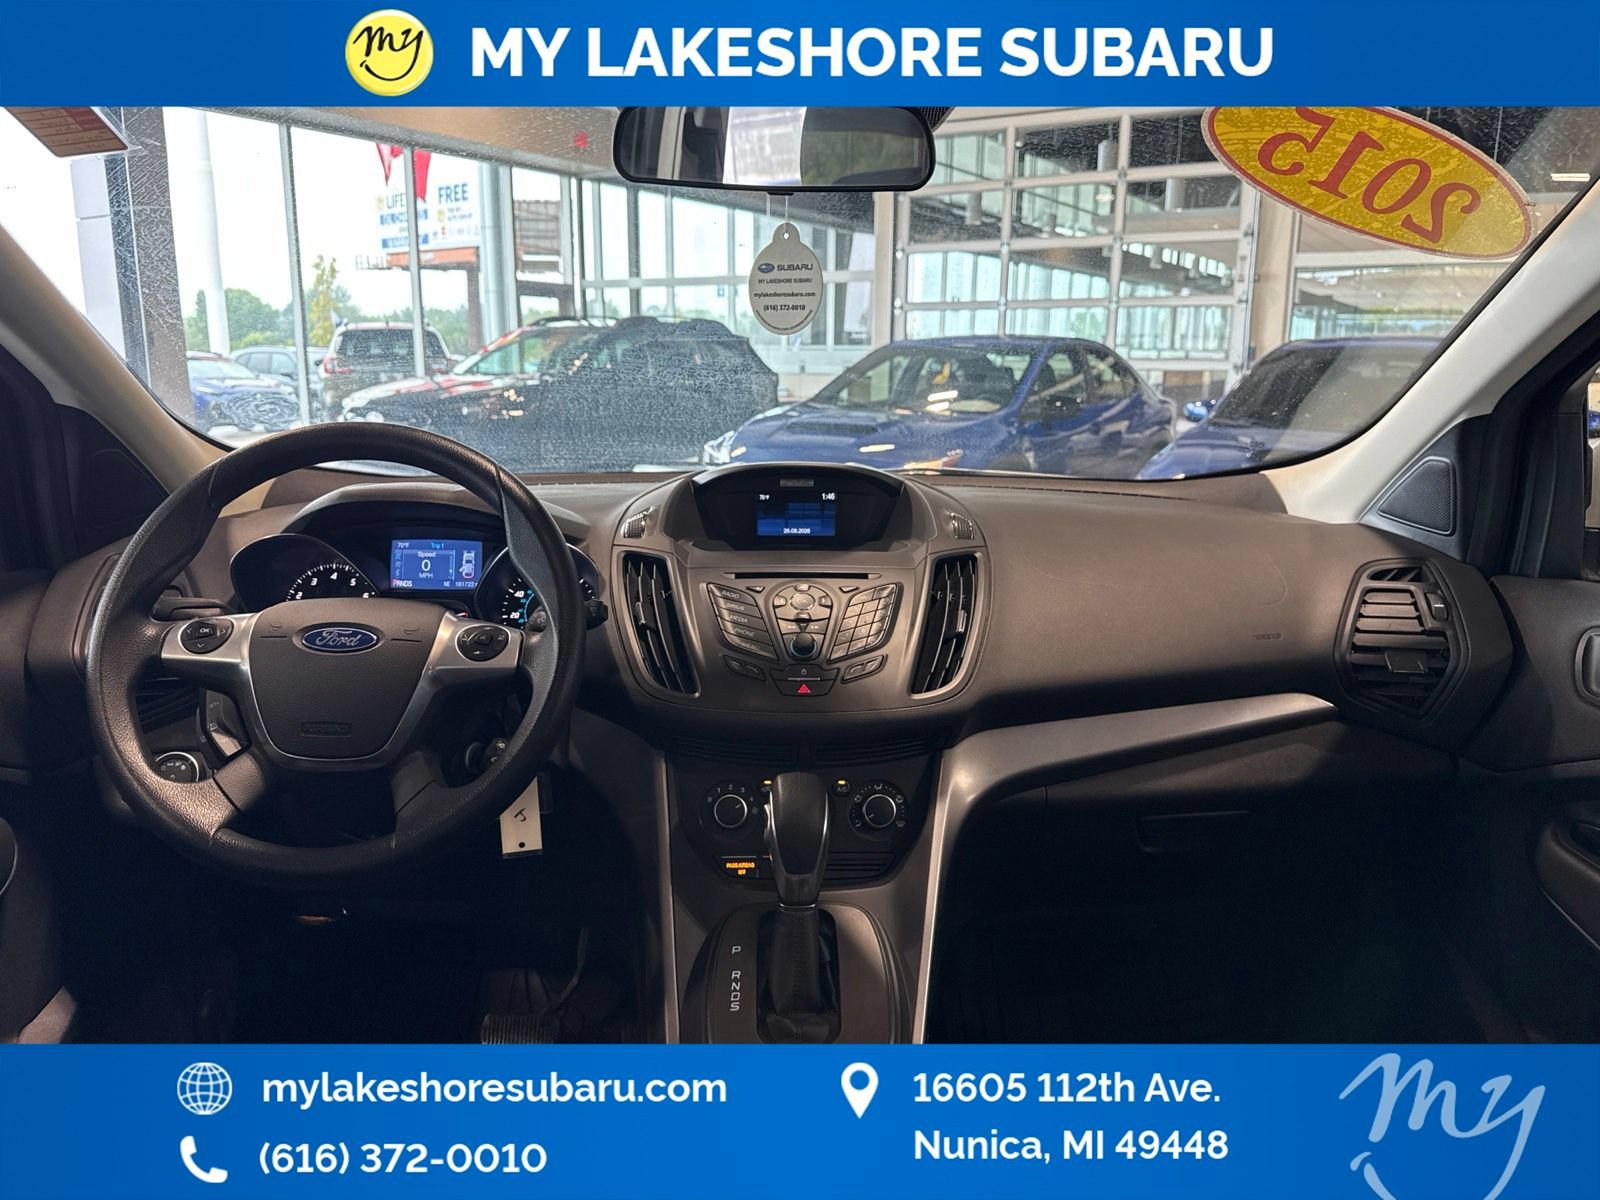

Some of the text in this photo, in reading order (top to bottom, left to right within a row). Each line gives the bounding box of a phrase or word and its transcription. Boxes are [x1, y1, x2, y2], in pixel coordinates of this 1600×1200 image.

[438, 183, 469, 204] FREE
[776, 263, 814, 271] SUBARU
[753, 291, 816, 299] mylakeshoresubaru.com
[763, 304, 779, 312] (616)
[421, 559, 431, 572] 0
[330, 572, 338, 580] 4
[310, 577, 318, 586] 3
[349, 578, 357, 587] 5
[295, 591, 303, 600] 2
[514, 590, 525, 598] 40
[721, 590, 740, 599] RADIO
[509, 611, 521, 619] 20
[730, 614, 748, 623] MEDIA
[734, 627, 755, 637] PHONE
[315, 630, 362, 646] Ford
